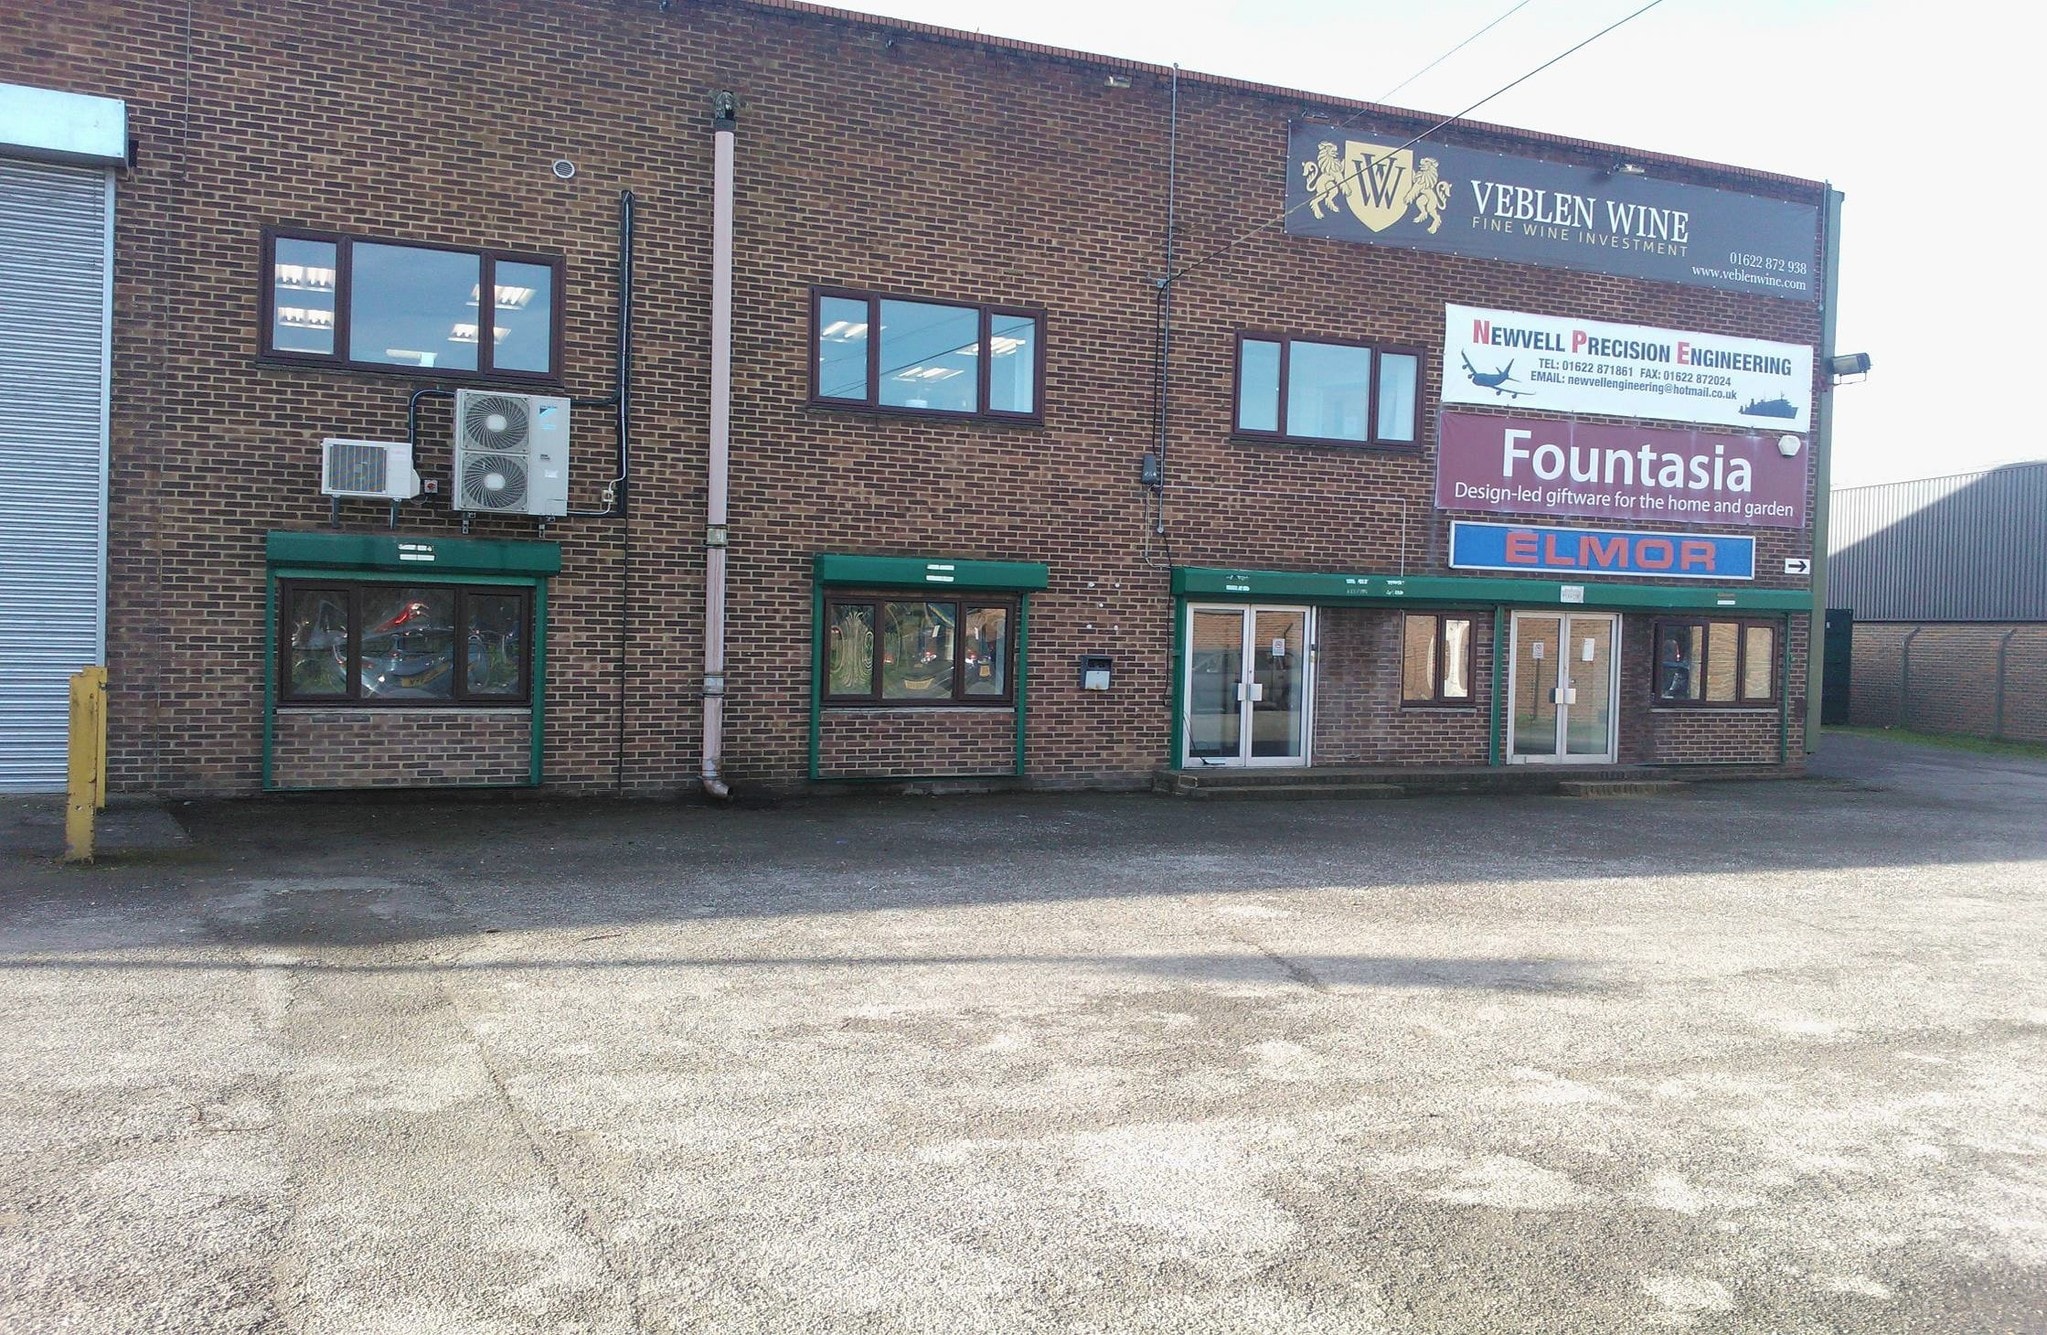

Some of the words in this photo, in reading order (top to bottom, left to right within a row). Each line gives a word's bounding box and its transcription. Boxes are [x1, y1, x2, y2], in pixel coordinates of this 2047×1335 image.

[1470, 179, 1596, 230] VEBLEN
[1606, 200, 1689, 243] WINE
[1472, 216, 1513, 233] FINE
[1523, 223, 1569, 241] WINE
[1579, 232, 1688, 257] INVESTMENT
[1691, 266, 1807, 291] www.veblenwine.com
[1729, 251, 1763, 268] 01622
[1765, 257, 1785, 272] 872
[1787, 260, 1807, 275] 938
[1530, 370, 1566, 384] EMAIL:
[1567, 375, 1738, 400] newvellengineering@hotmail.co.uk
[1538, 357, 1560, 370] TEL:
[1562, 360, 1594, 374] 01622
[1596, 363, 1634, 377] 871861
[1640, 367, 1661, 380] FAX:
[1663, 370, 1693, 384] 01622
[1695, 373, 1732, 387] 872024
[1502, 428, 1752, 493] Fountasia
[1455, 481, 1542, 503] Design-led
[1546, 487, 1611, 507] giftware
[1614, 490, 1637, 508] for
[1639, 493, 1665, 510] the
[1668, 494, 1711, 513] home
[1713, 498, 1741, 514] and
[1744, 500, 1794, 518] garden
[1505, 530, 1716, 572] ELMOR
